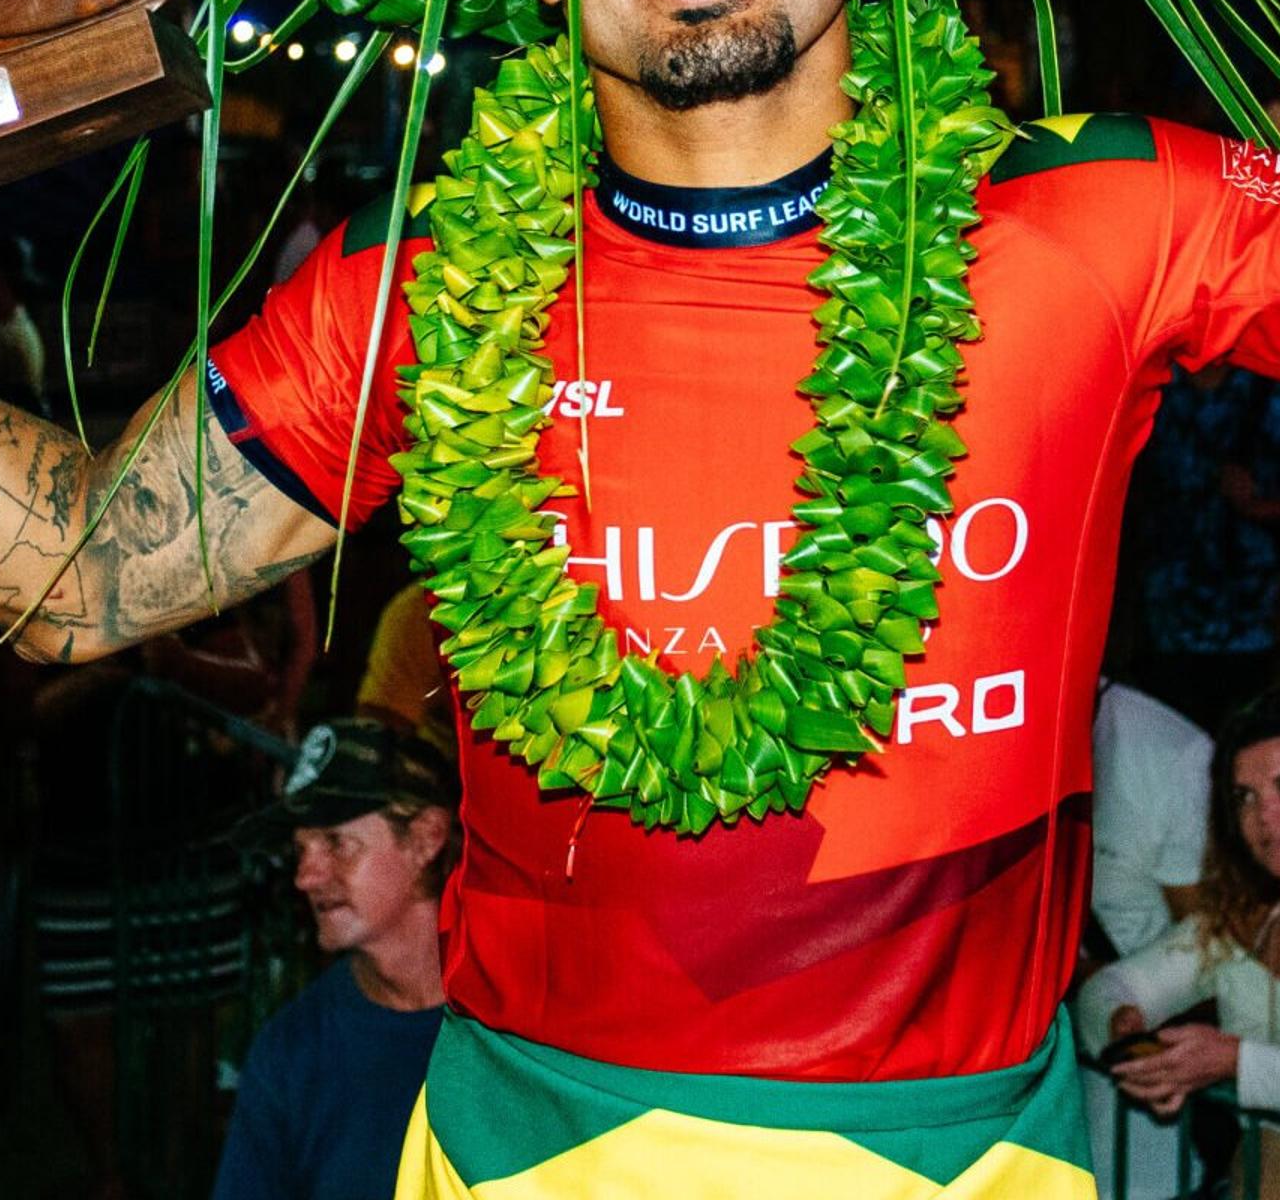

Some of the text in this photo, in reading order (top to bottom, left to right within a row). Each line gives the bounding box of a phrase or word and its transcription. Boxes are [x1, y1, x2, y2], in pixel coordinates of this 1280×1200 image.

[611, 189, 686, 232] WORLD
[691, 208, 764, 234] SURF
[896, 669, 1025, 745] RO
